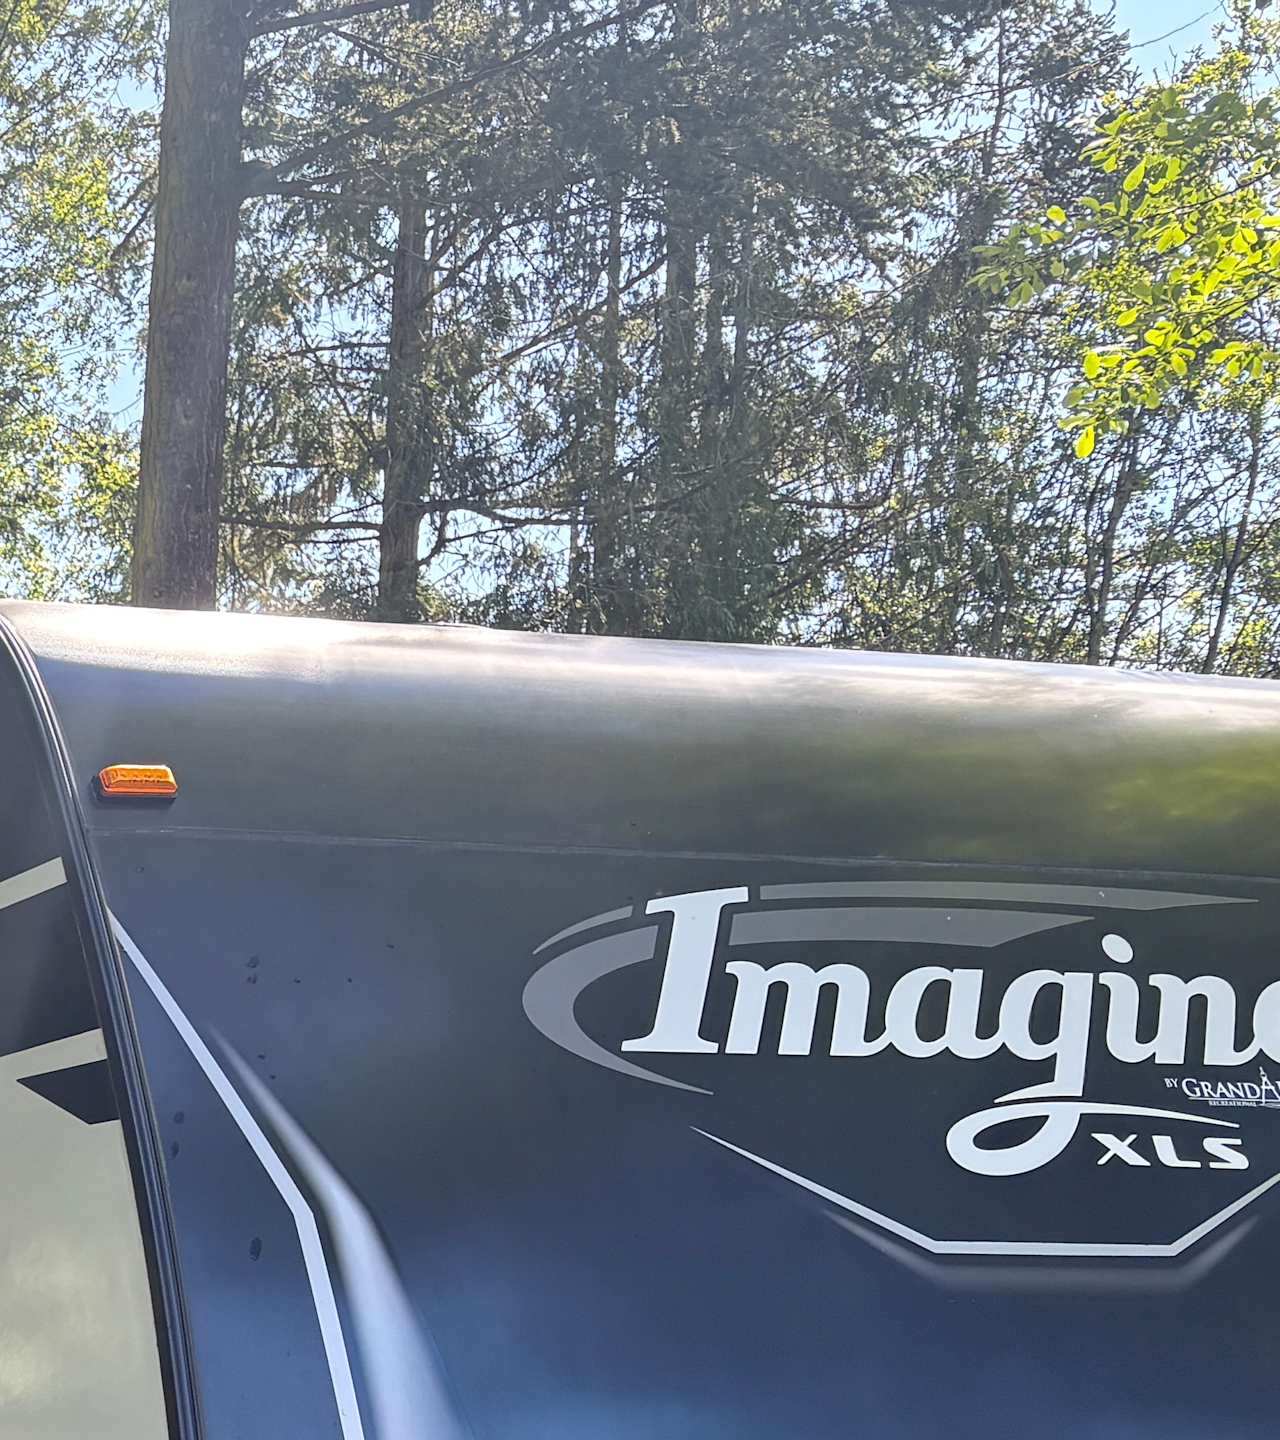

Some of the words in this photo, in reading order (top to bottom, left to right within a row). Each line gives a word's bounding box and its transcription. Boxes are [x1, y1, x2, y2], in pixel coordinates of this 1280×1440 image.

[621, 886, 1280, 1176] Imagin
[1164, 1078, 1178, 1088] BY
[1091, 1132, 1250, 1169] XLS
